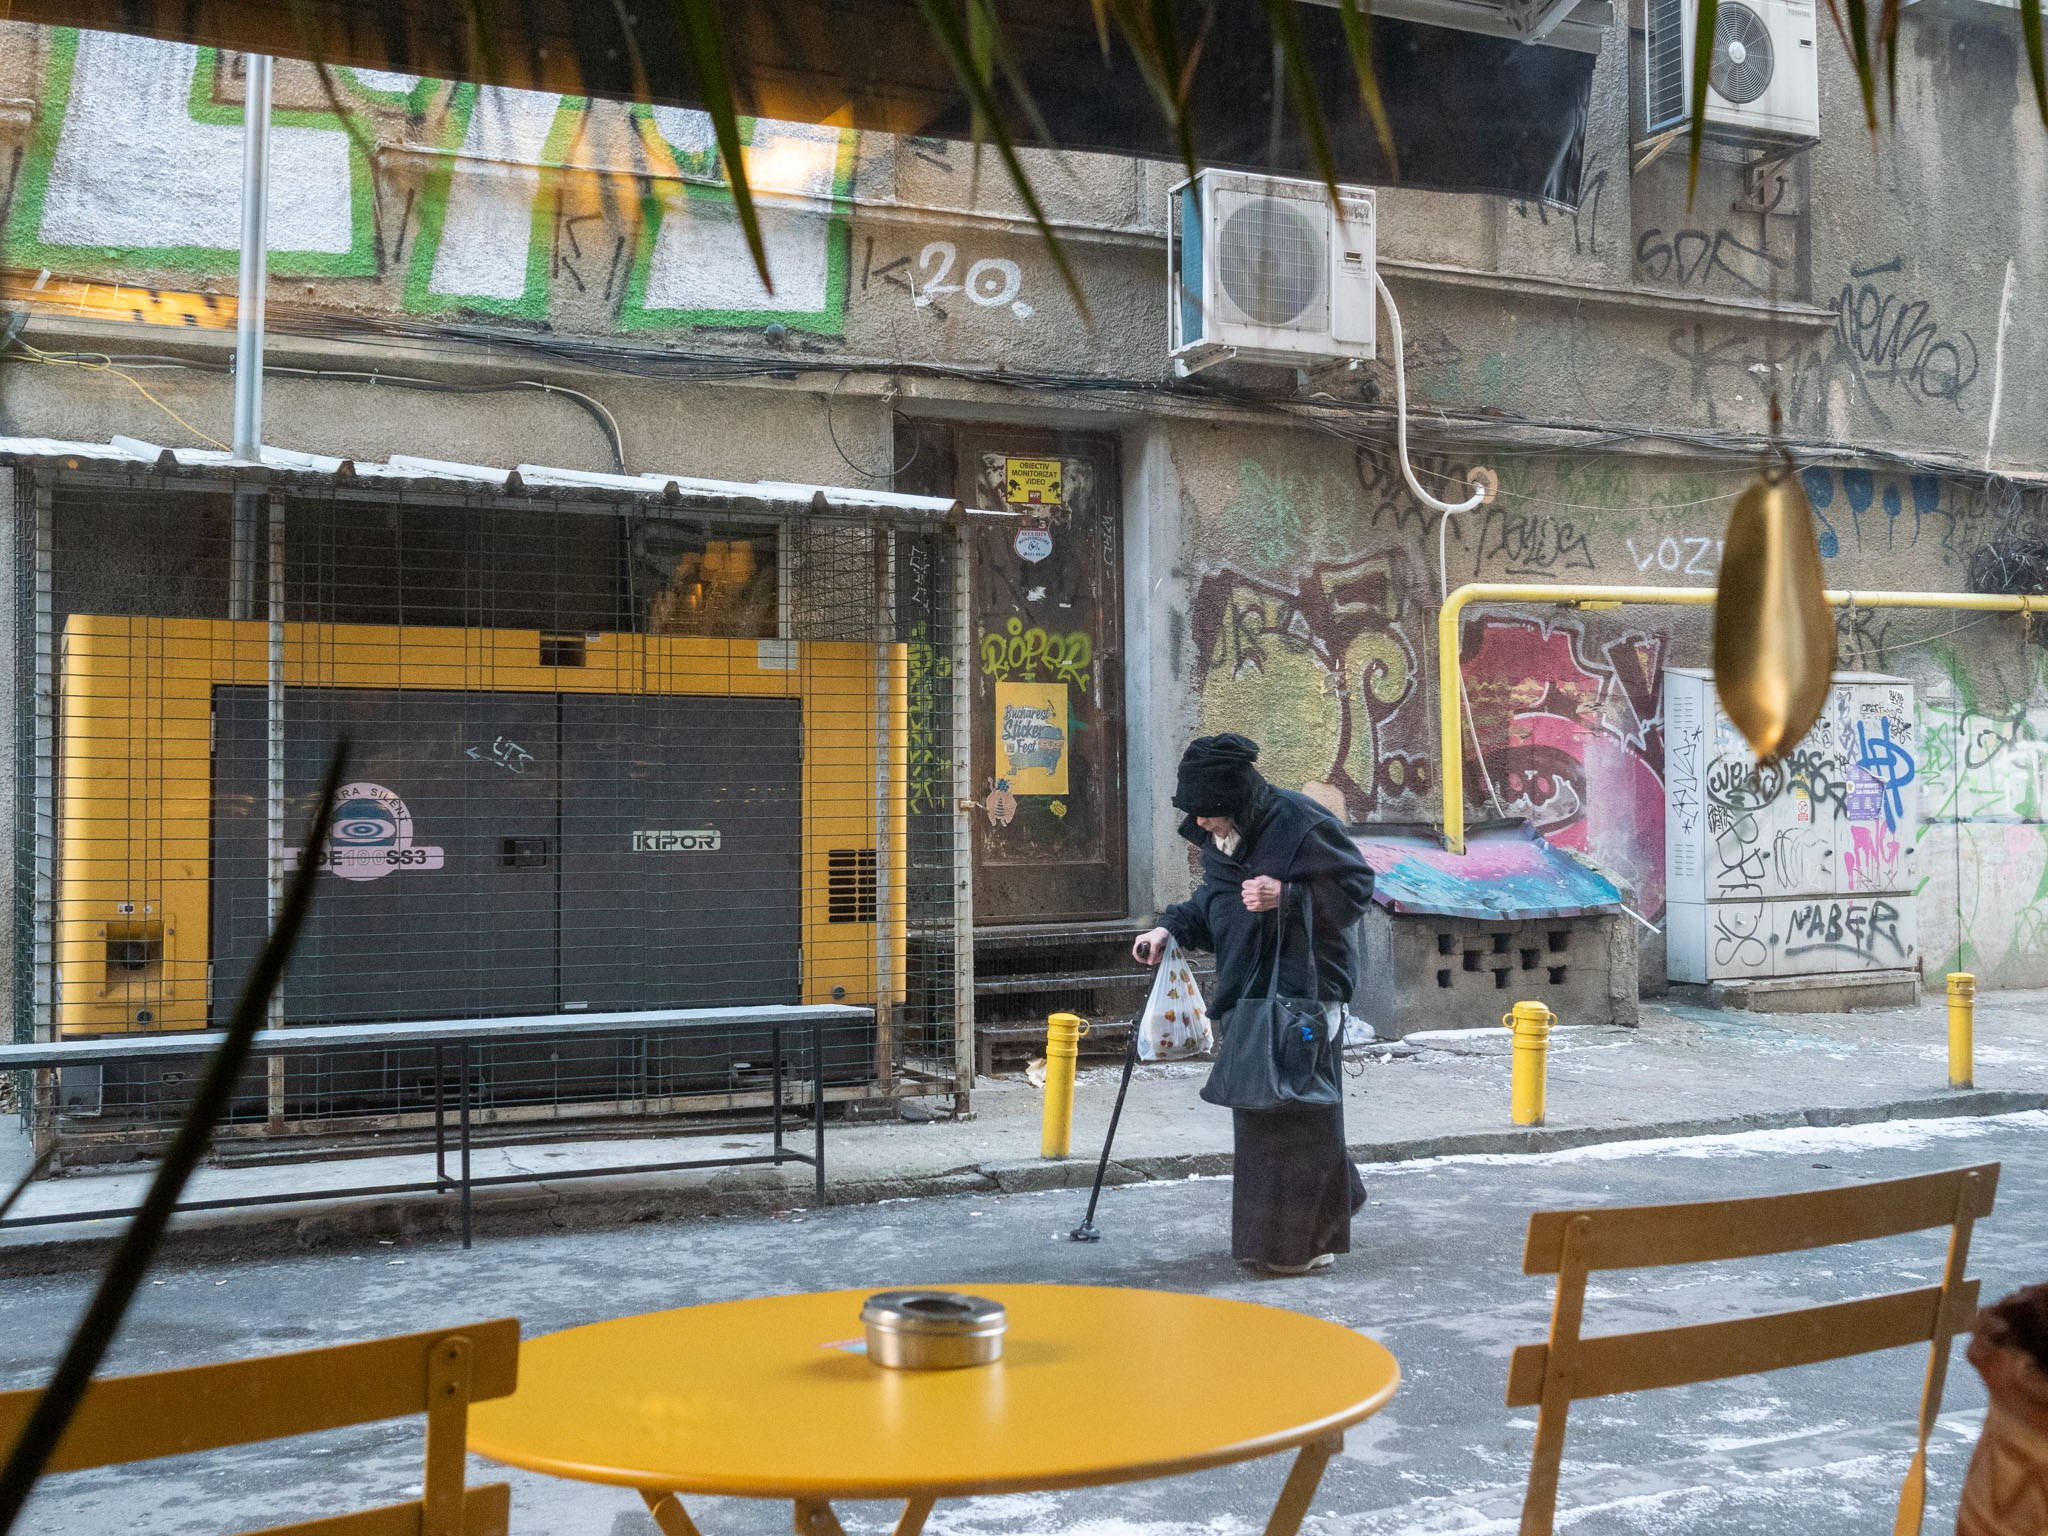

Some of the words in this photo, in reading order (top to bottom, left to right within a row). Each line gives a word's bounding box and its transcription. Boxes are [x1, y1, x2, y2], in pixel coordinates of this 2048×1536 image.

[1019, 461, 1050, 469] OBIECTIV
[1011, 469, 1057, 478] MONITORIZAT
[1004, 704, 1048, 720] Bucharest
[1016, 738, 1037, 754] Fest
[370, 787, 408, 822] SILENT
[636, 835, 714, 850] KIPOR
